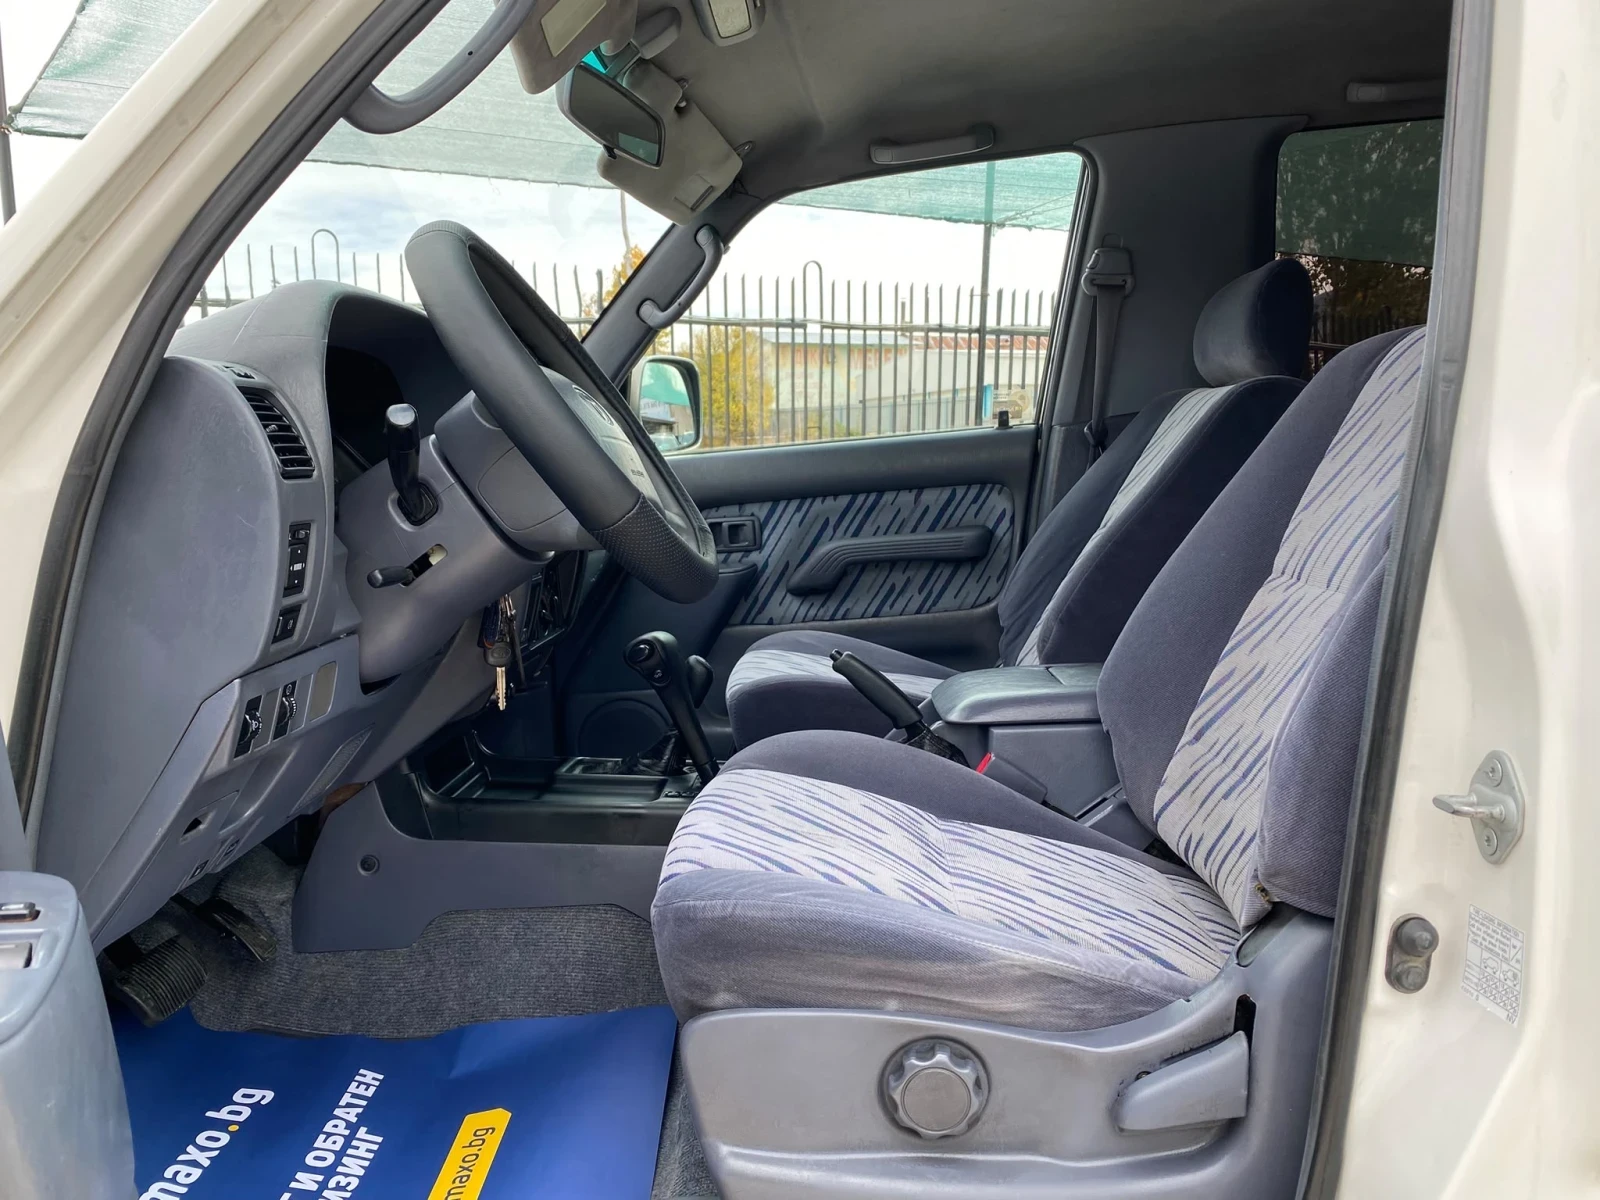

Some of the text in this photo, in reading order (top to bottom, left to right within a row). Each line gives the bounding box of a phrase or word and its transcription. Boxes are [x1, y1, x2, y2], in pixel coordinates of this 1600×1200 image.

[138, 1087, 275, 1200] maxo.bg
[288, 1068, 385, 1191] И ОБРАТЕН
[444, 1126, 496, 1200] maxo.bg
